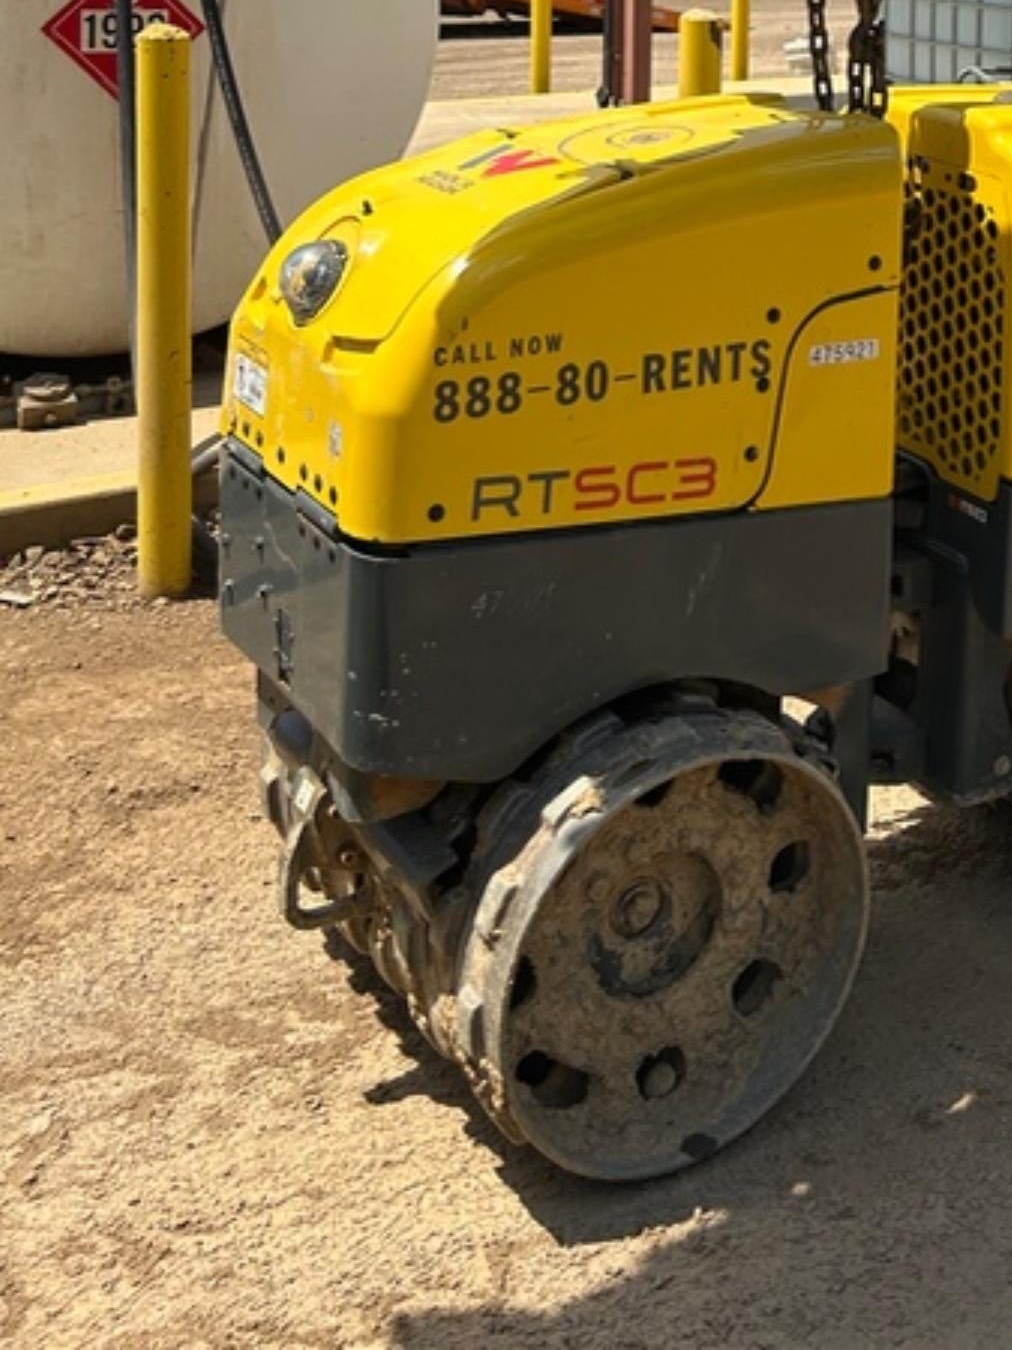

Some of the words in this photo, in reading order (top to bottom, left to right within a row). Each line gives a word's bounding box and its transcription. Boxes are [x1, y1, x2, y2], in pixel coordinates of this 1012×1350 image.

[433, 338, 772, 424] 888-80-RENTS
[434, 341, 497, 367] CALL
[509, 334, 563, 358] NOW
[471, 457, 718, 521] RTSC3
